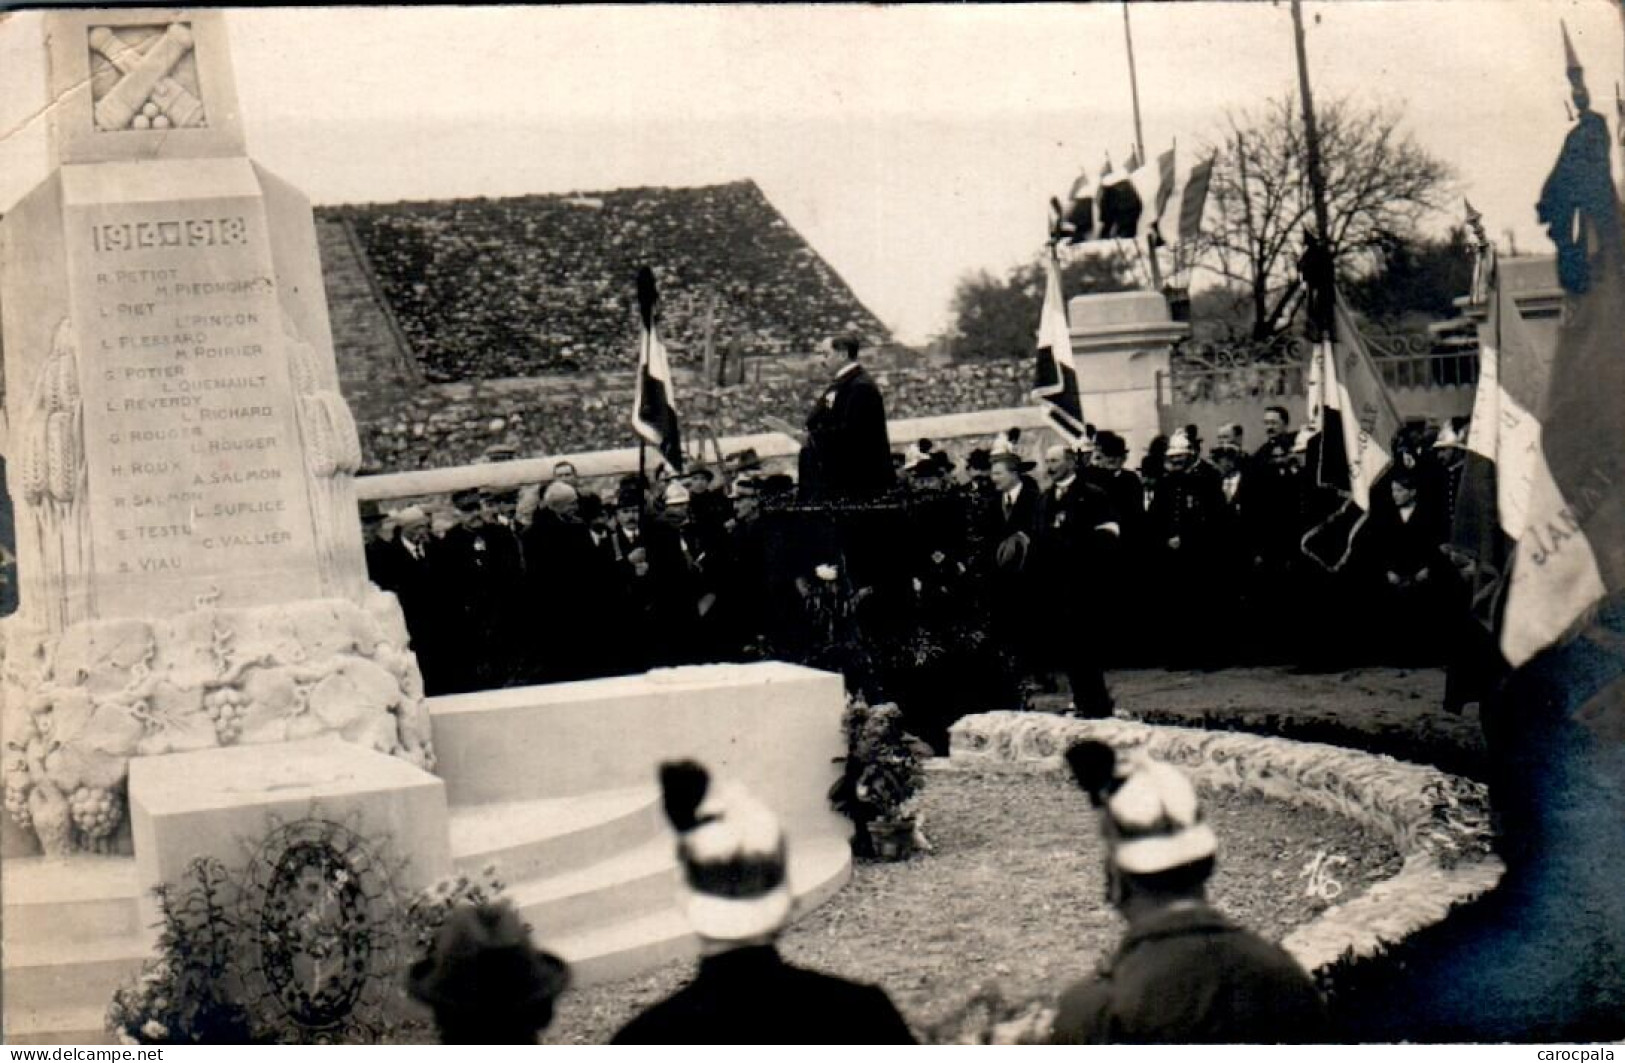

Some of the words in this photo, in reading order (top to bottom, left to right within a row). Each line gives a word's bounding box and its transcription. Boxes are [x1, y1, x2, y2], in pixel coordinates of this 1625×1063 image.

[116, 268, 178, 284] PETIOT
[194, 344, 262, 358] POIRIER
[125, 364, 185, 379] POTIER
[124, 395, 202, 411] REVERDY
[200, 405, 273, 421] RICHARD
[130, 425, 203, 442] ROUGER
[208, 436, 276, 452] ROUGER
[131, 460, 181, 474] ROUX
[210, 469, 281, 484] SALMON
[133, 492, 203, 507] SALMON
[213, 499, 286, 516] SUPLICE
[135, 524, 192, 539] TESTU
[220, 531, 291, 547] VALLIER
[138, 556, 181, 572] VIAU
